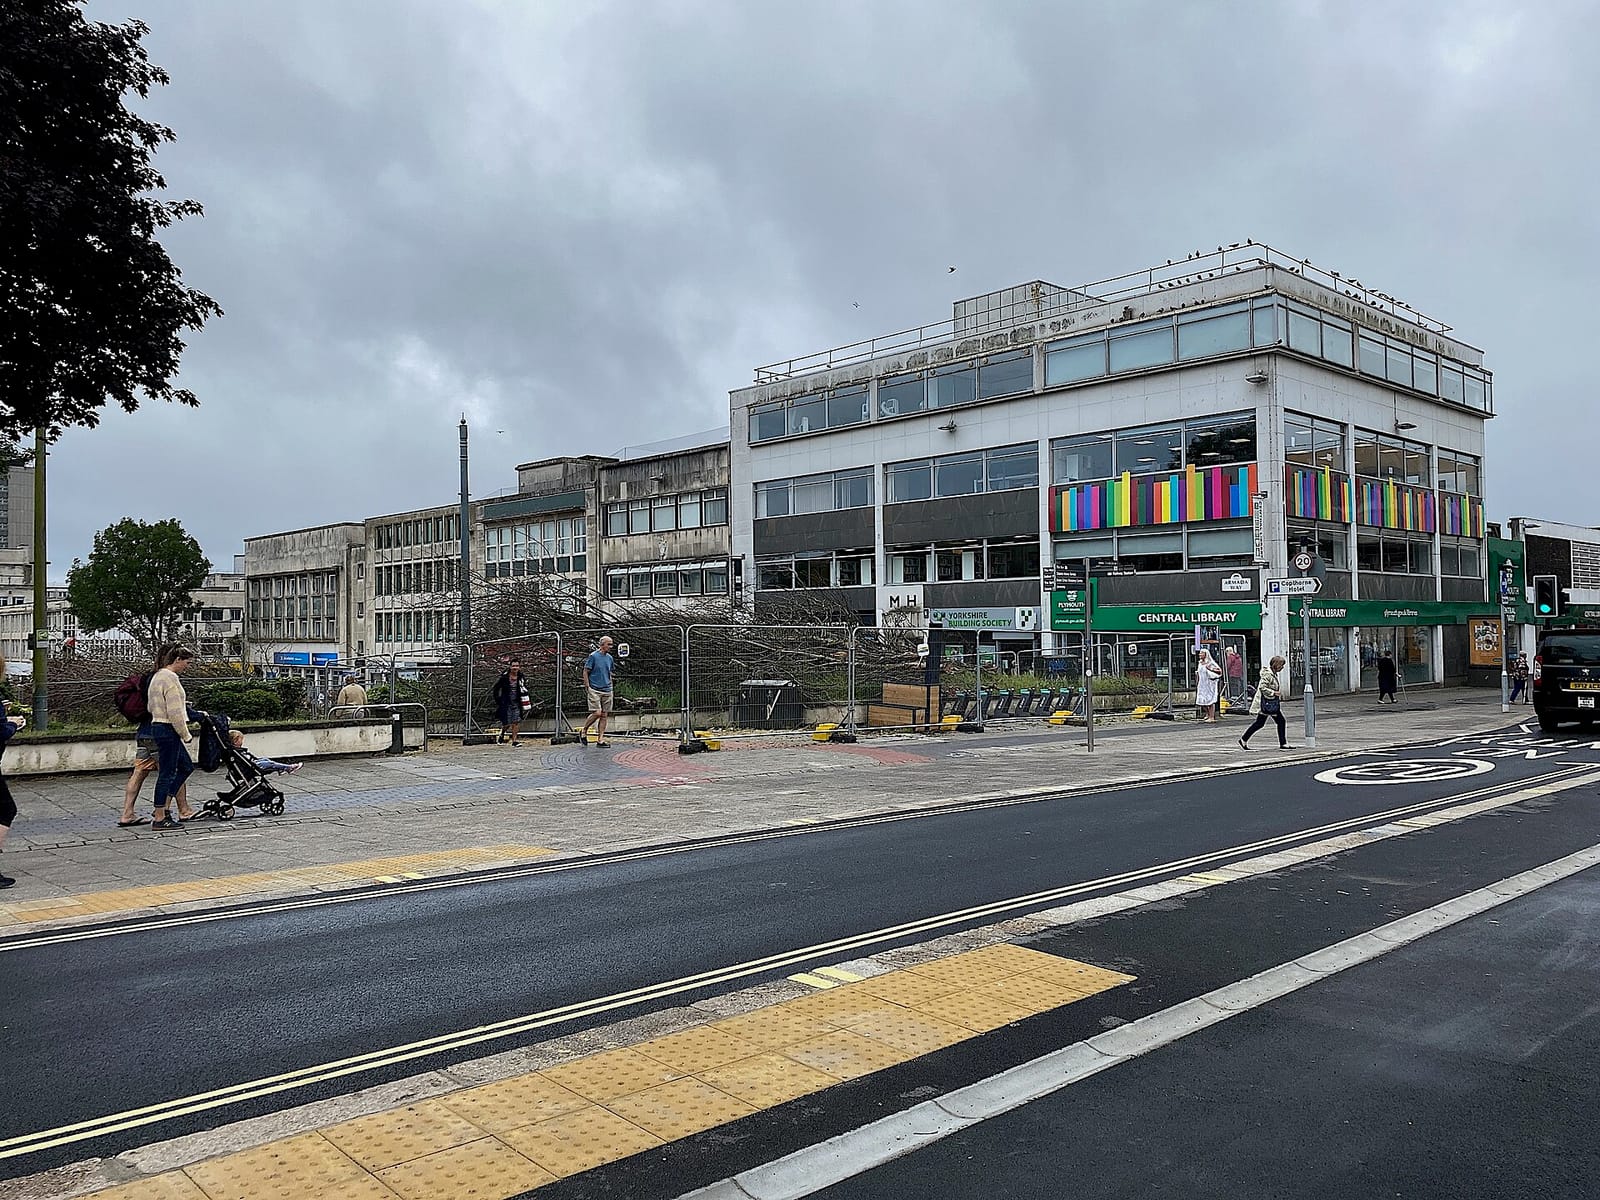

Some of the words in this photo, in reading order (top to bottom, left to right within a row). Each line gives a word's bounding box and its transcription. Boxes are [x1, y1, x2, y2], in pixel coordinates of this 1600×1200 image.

[1297, 557, 1310, 566] 20
[1281, 580, 1312, 589] Copthorne
[948, 611, 988, 619] YORKSHIRE
[1138, 613, 1188, 623] CENTRAL
[1191, 612, 1237, 622] LIBRARY
[1299, 608, 1324, 618] CNTRAL
[1325, 608, 1347, 618] LIBRARY
[948, 620, 980, 628] BUILDING
[982, 619, 1012, 627] SOCIETY
[1340, 763, 1468, 778] 20
